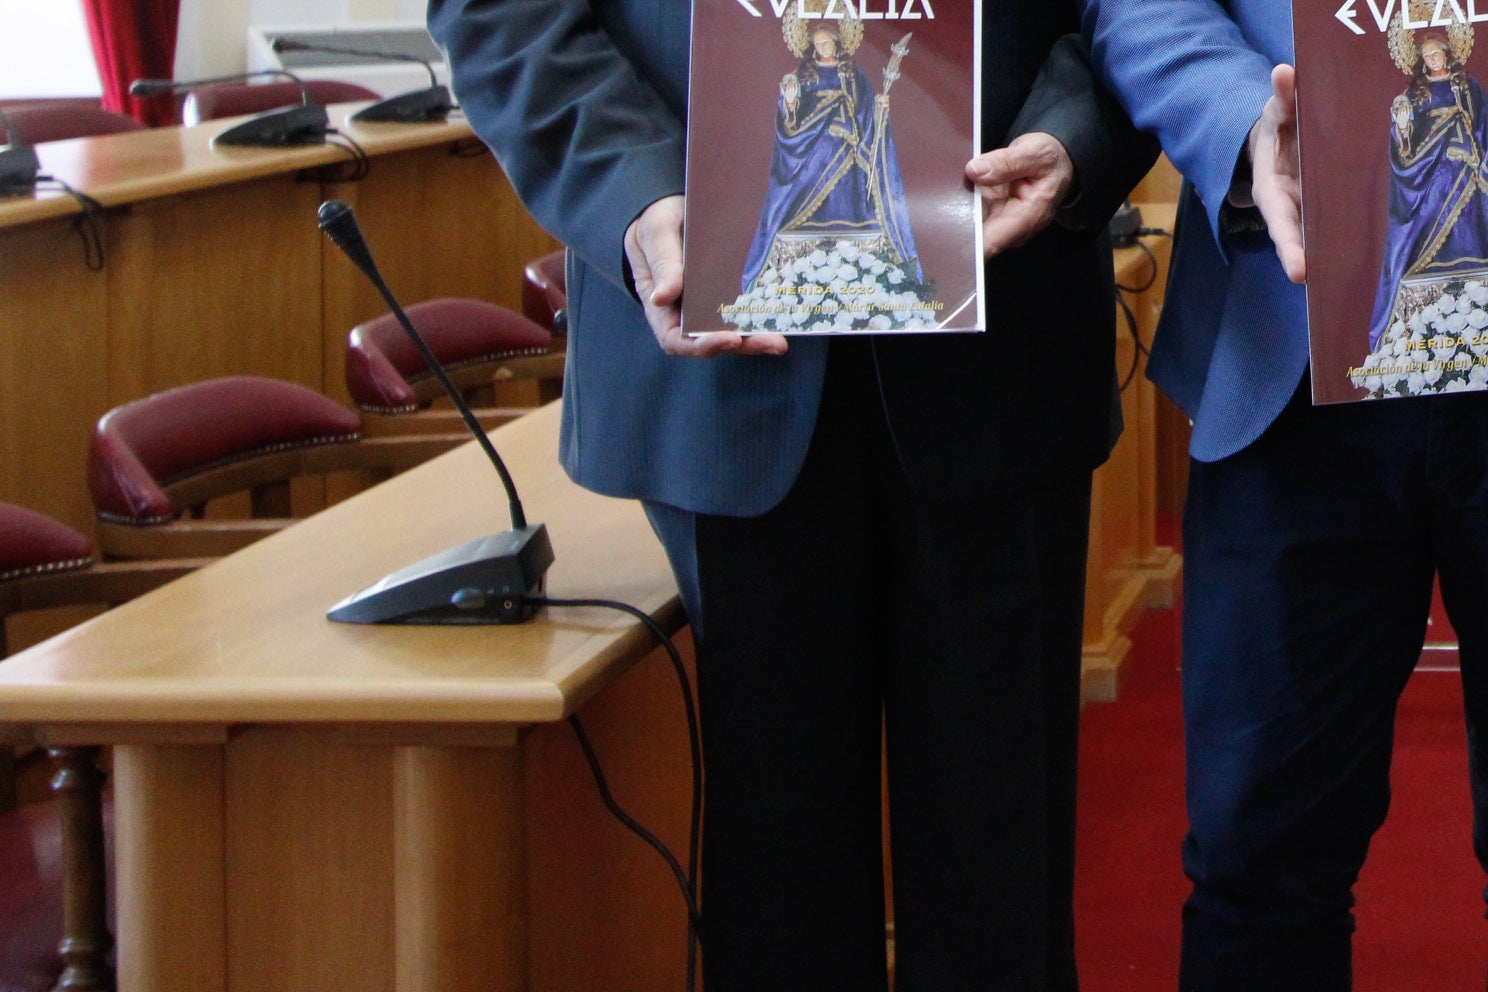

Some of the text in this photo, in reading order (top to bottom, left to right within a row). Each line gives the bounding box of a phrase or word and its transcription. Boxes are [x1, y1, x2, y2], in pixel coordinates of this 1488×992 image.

[839, 286, 876, 295] 2020
[1404, 337, 1466, 351] MÉRIDA
[1434, 358, 1466, 372] Virgen
